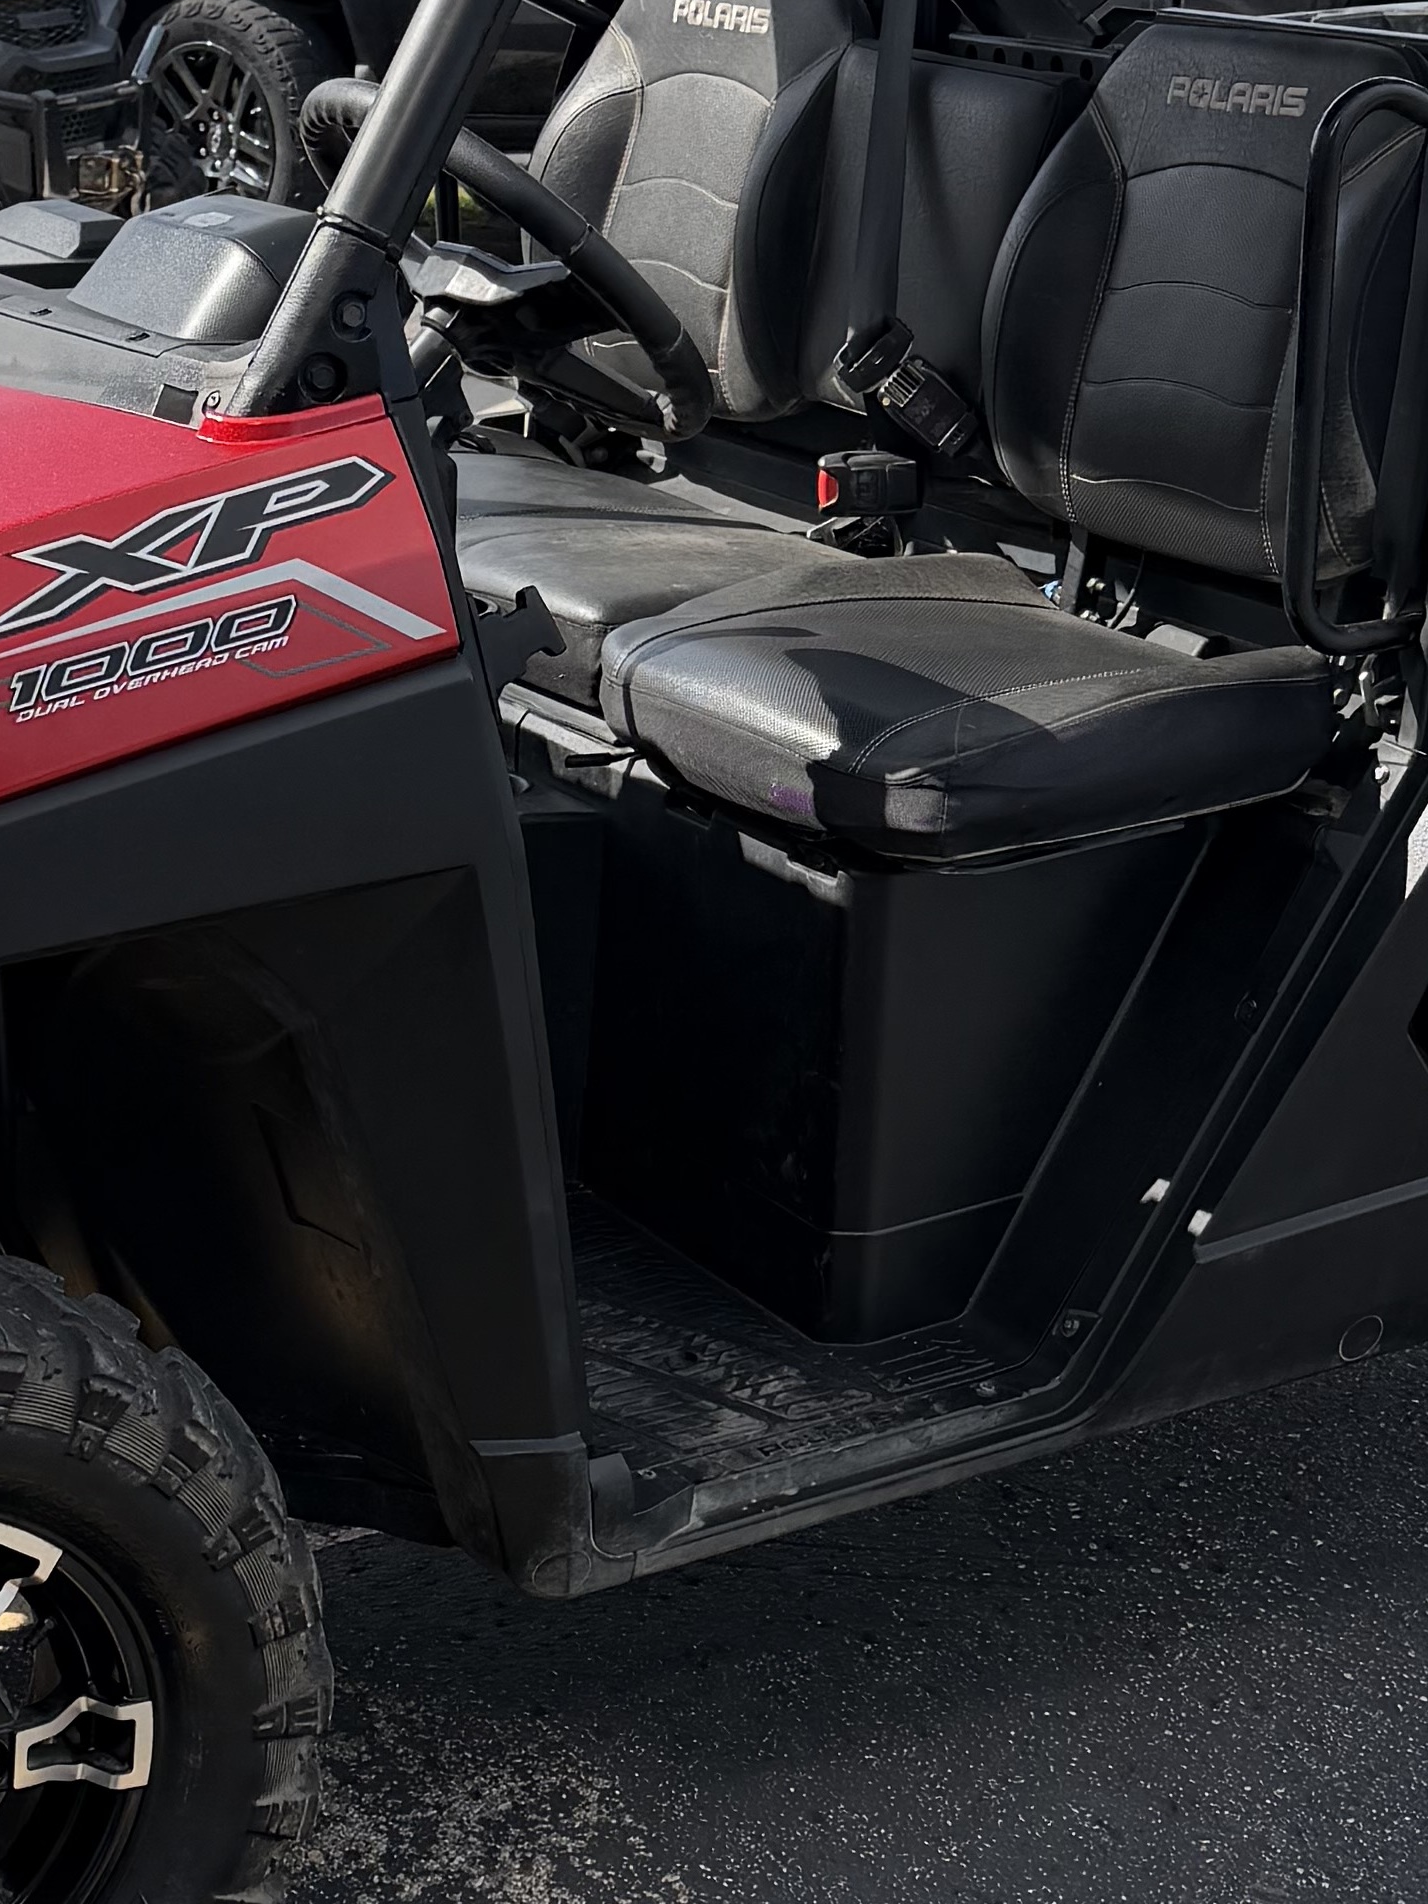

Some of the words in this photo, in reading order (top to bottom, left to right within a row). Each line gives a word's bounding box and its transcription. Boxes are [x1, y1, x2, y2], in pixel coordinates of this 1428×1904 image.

[1167, 75, 1309, 118] POLARIS
[9, 593, 298, 713] 1000
[15, 692, 86, 724] DUAL
[92, 651, 229, 702] OVERHEAD
[234, 634, 291, 662] CAM
